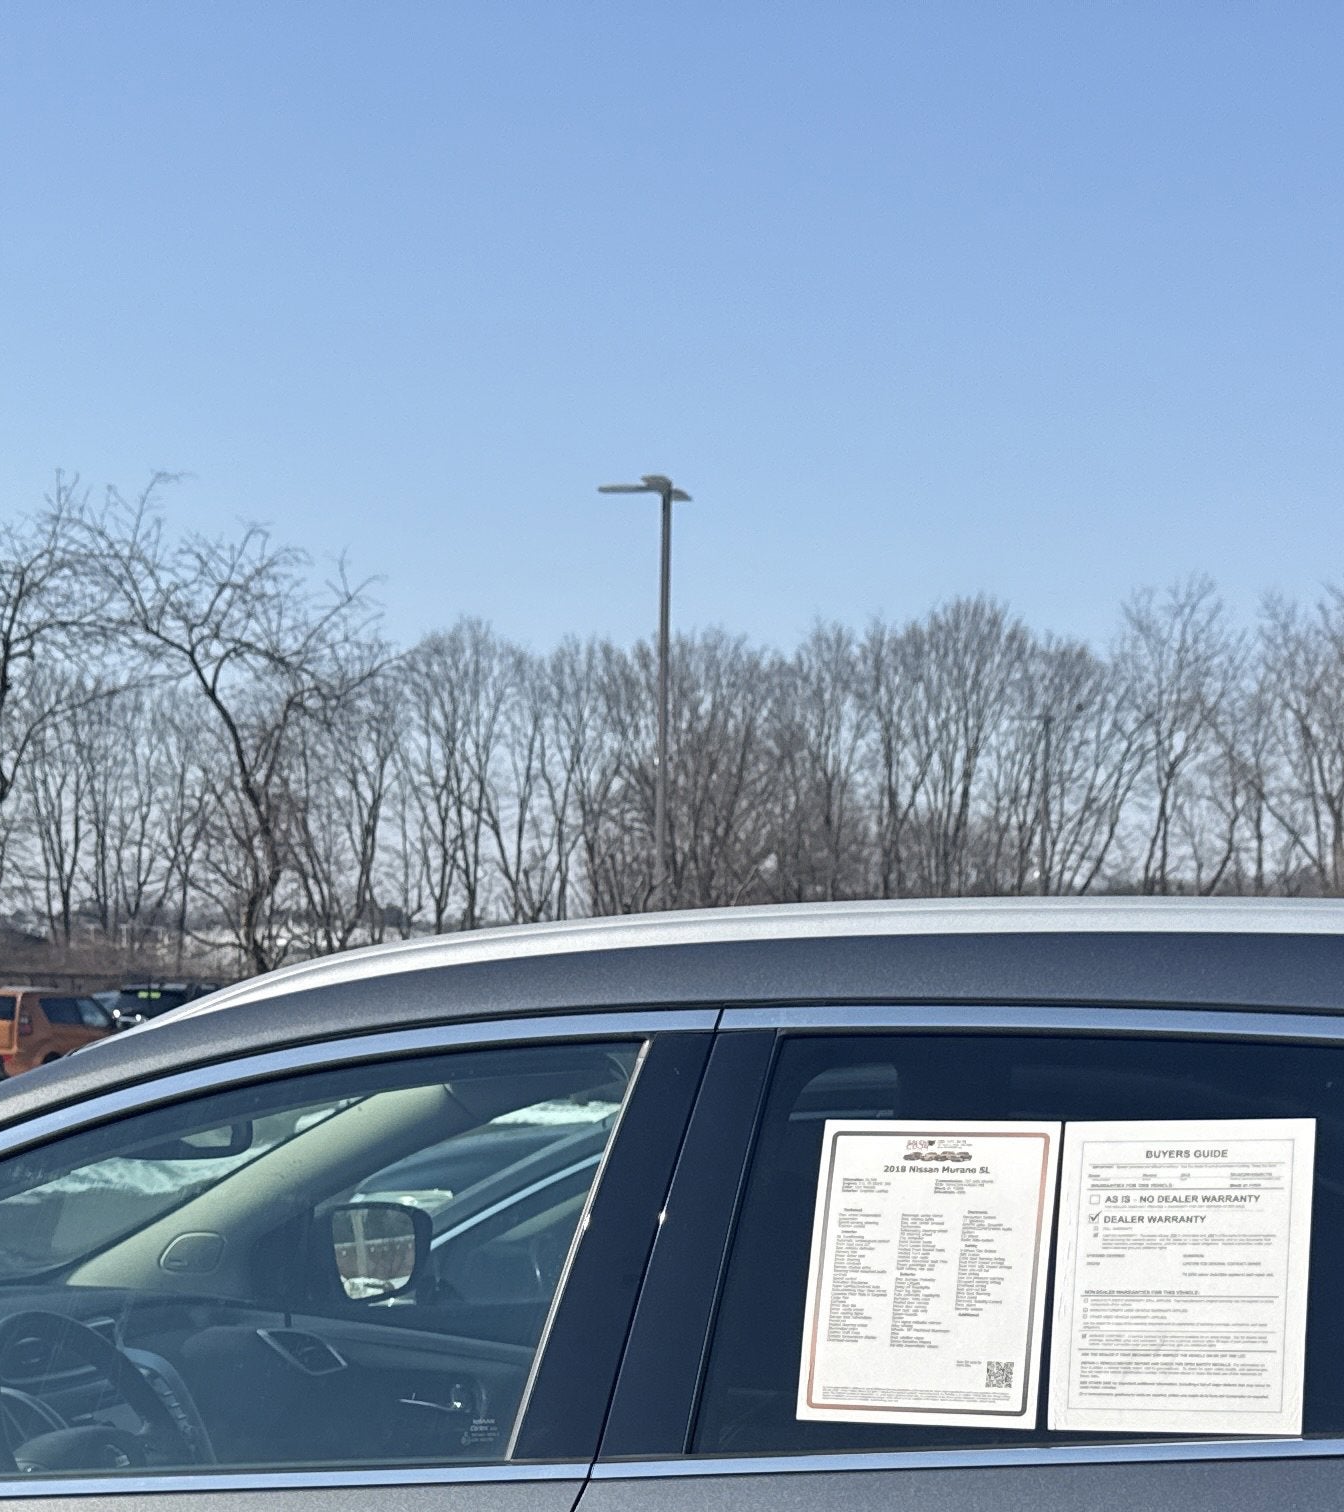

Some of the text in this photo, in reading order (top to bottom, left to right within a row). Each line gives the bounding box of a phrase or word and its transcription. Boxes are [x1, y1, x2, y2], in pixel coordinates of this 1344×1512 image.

[1145, 1149, 1229, 1159] BUYERS GUIDE
[883, 1165, 907, 1173] 2018
[942, 1166, 977, 1174] Murano
[979, 1166, 991, 1174] SL
[1105, 1195, 1118, 1203] AS
[1121, 1195, 1131, 1203] IS
[1139, 1195, 1155, 1203] NO
[1157, 1195, 1199, 1203] DEALER
[1201, 1194, 1261, 1203] WARRANTY
[1103, 1215, 1207, 1224] DEALER WARRANTY
